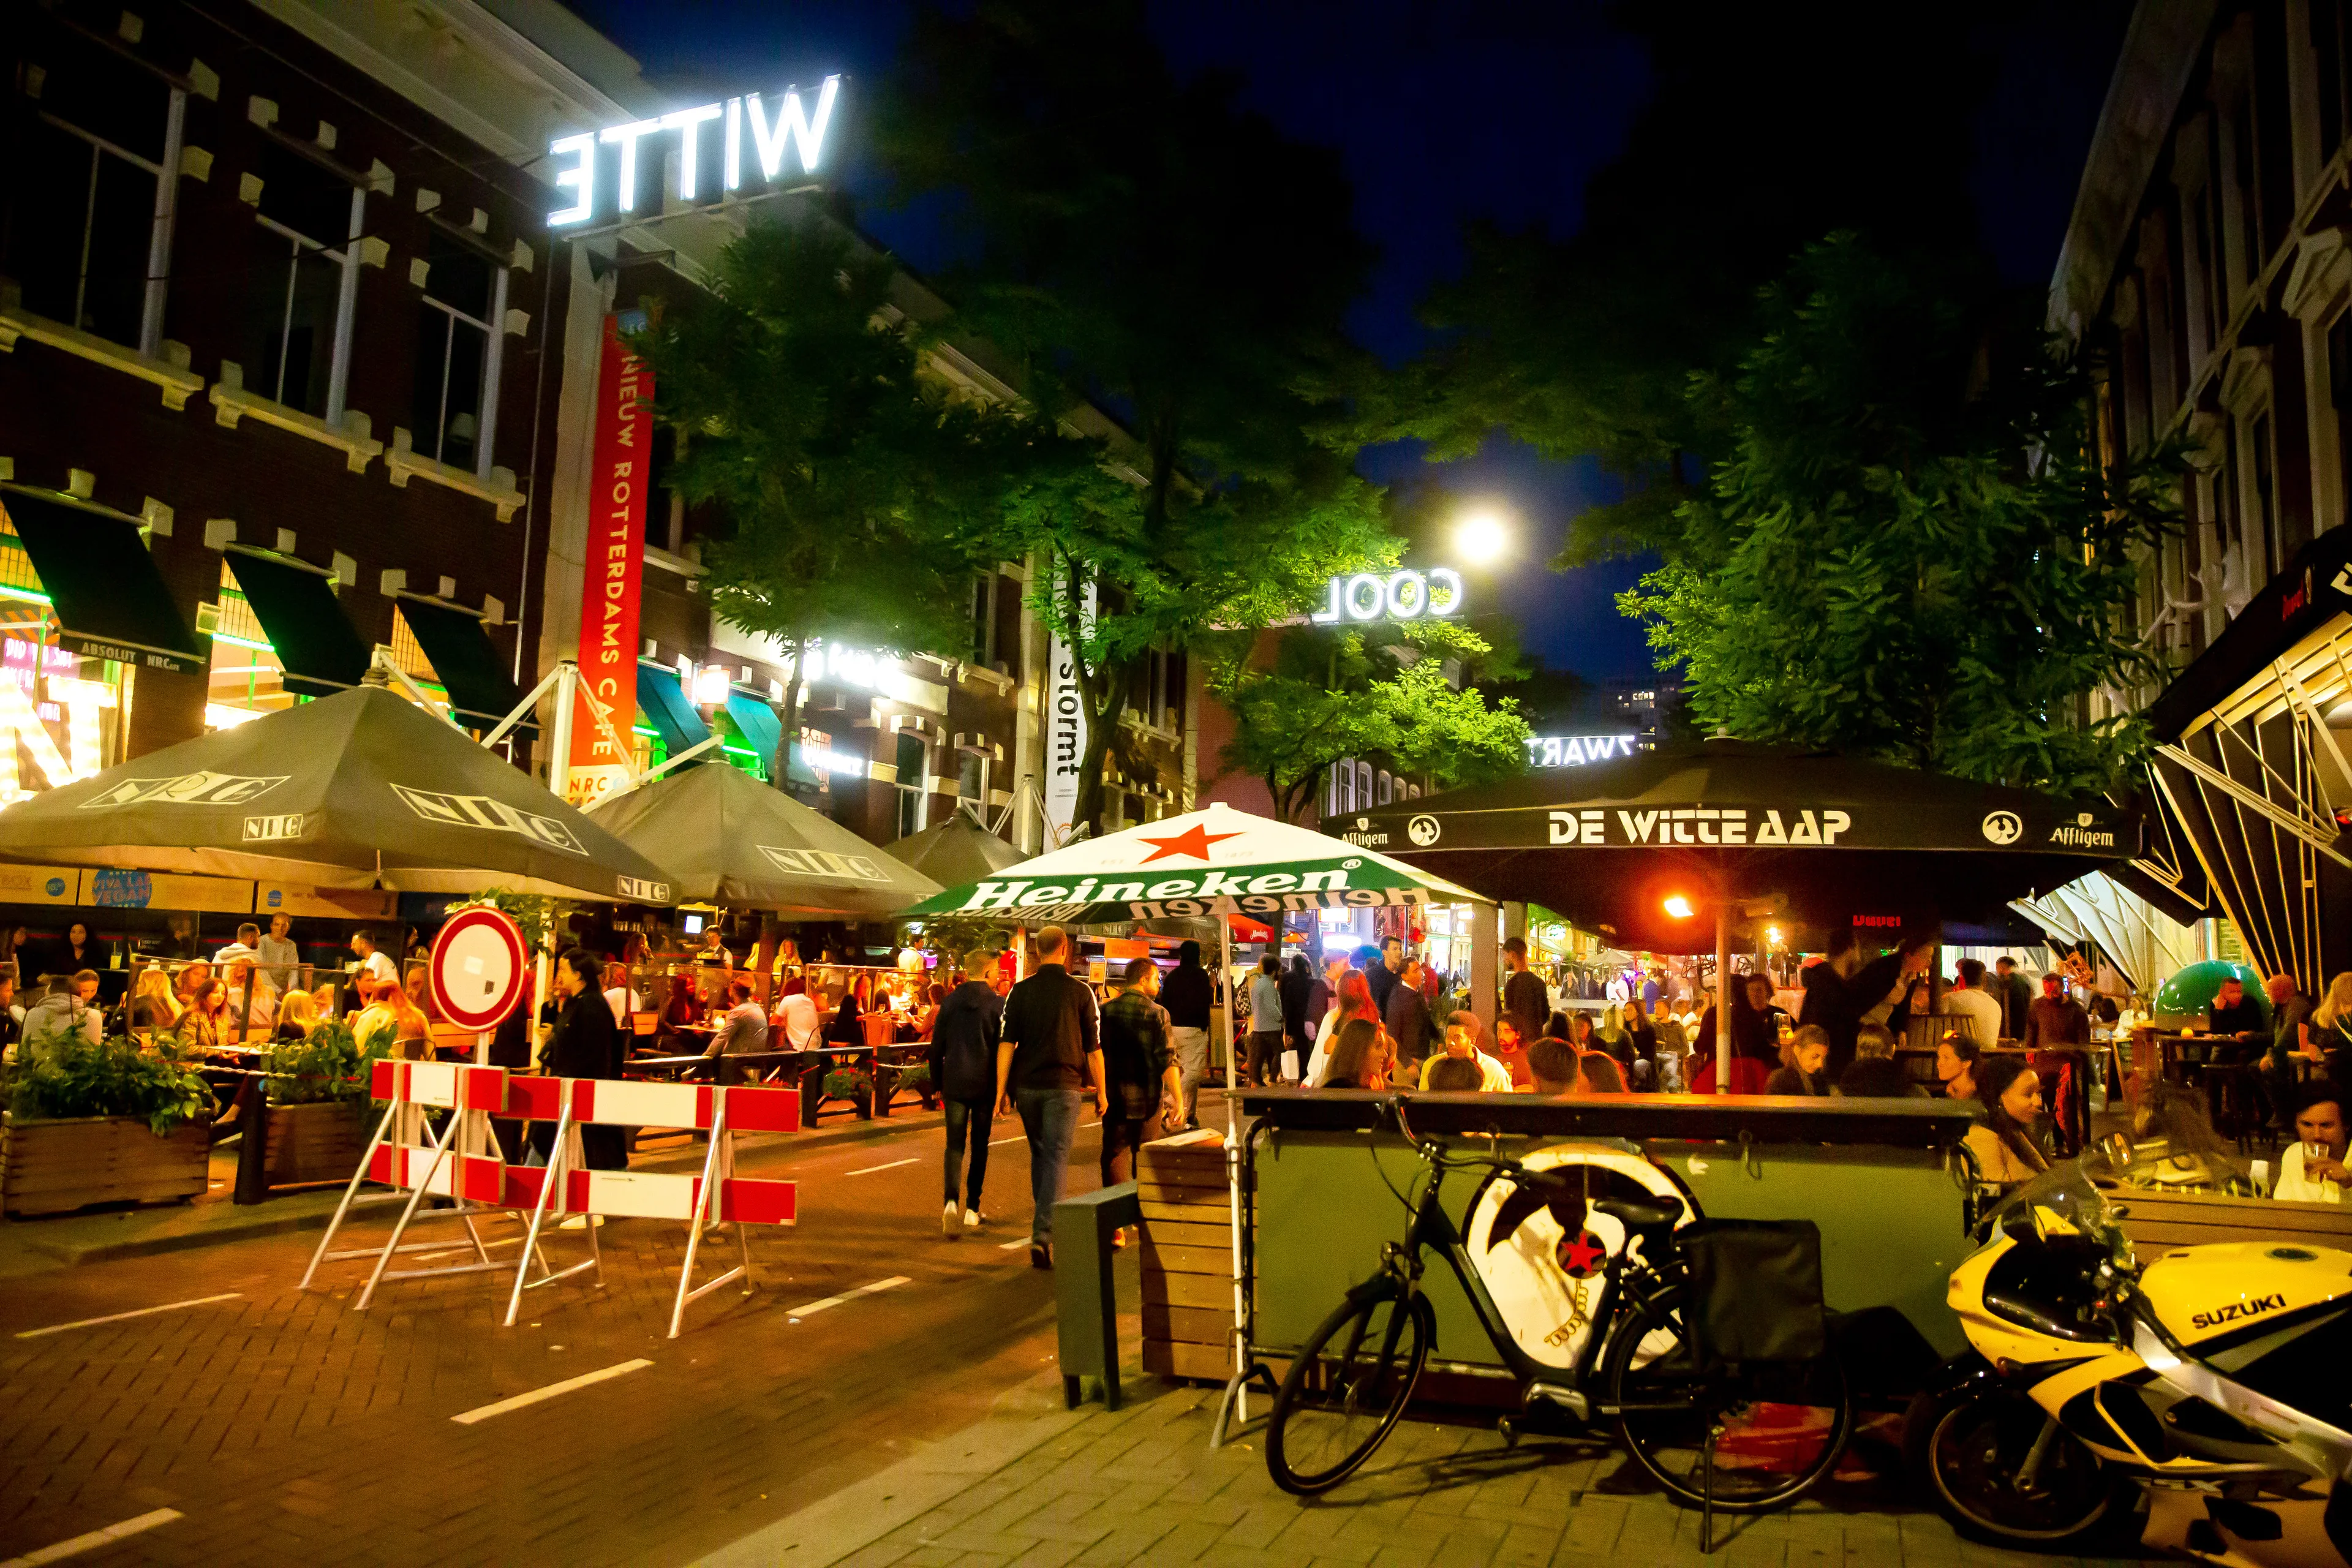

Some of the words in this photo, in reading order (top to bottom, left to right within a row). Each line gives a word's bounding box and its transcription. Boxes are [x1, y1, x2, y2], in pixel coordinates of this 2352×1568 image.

[617, 355, 638, 447] NIEUW
[600, 461, 633, 664] ROTTERDAMS
[81, 642, 136, 663] ABSOLUT
[1057, 662, 1080, 777] stormt
[570, 777, 608, 794] NRC
[1342, 832, 1389, 848] Affligem
[1549, 811, 1604, 844] DE
[1755, 810, 1851, 845] AAP
[2048, 827, 2115, 848] Affligem
[957, 870, 1351, 911] Heineken
[2192, 1293, 2286, 1330] SUZUKI
